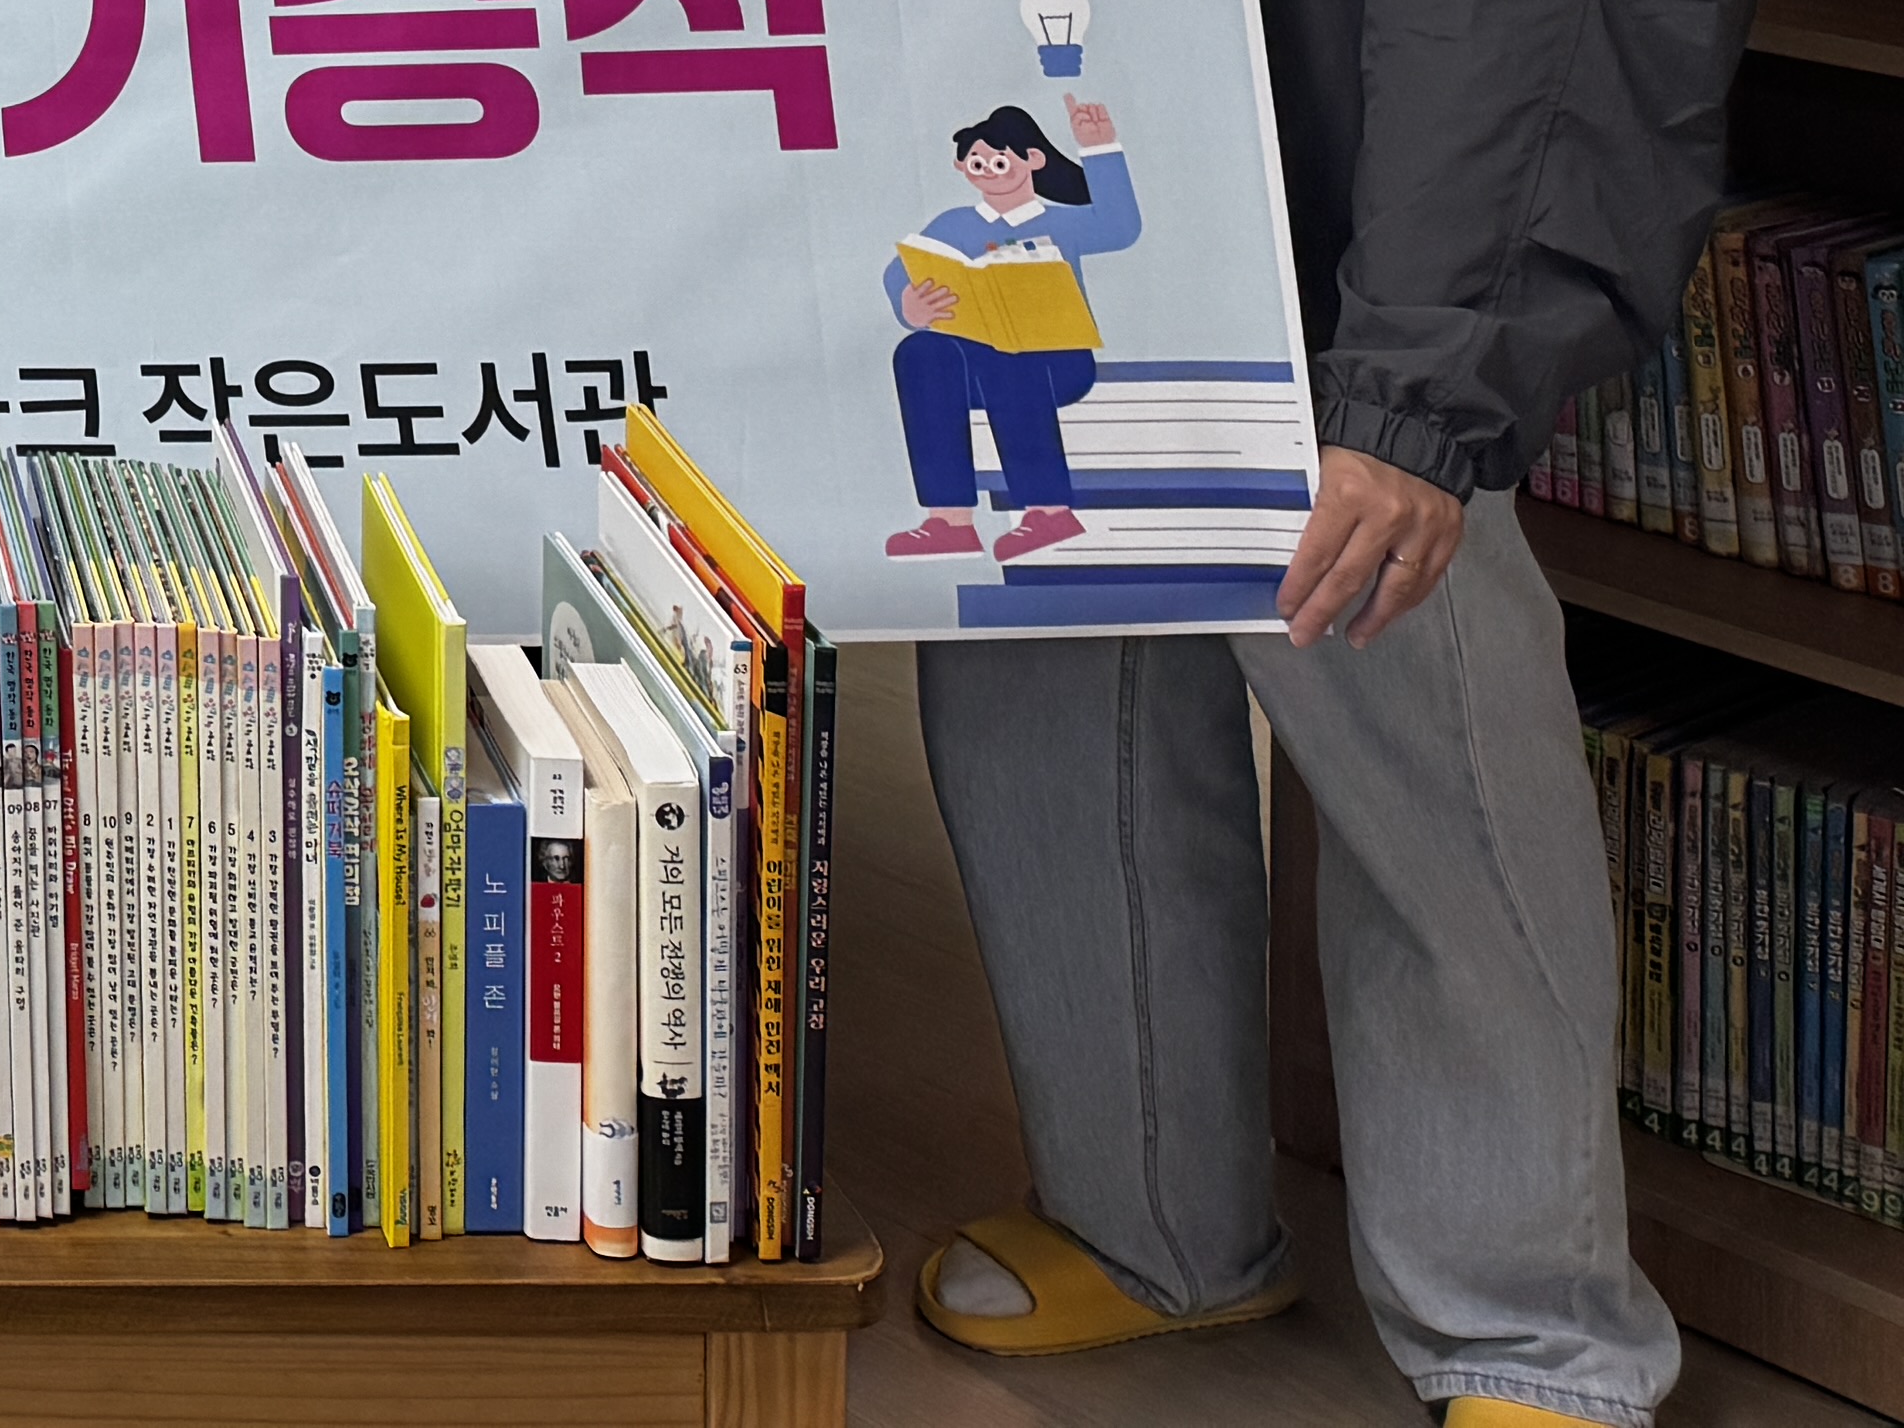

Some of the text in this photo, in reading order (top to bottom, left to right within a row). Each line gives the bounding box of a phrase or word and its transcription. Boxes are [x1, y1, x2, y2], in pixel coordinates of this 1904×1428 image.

[139, 348, 669, 470] 작은도서관
[733, 662, 749, 675] 63
[7, 804, 23, 815] 09
[24, 801, 41, 813] 08
[44, 800, 58, 810] 07
[82, 814, 92, 827] 8
[102, 816, 117, 829] 10
[124, 812, 133, 825] 9
[146, 814, 155, 827] 2
[167, 817, 174, 830] 1
[186, 815, 195, 829] 7
[207, 821, 217, 834] 6
[227, 822, 236, 836] 5
[246, 830, 255, 842] 4
[268, 830, 278, 843] 3
[392, 784, 410, 907] Where Is My House?
[11, 829, 23, 877] 송아지가
[65, 862, 78, 895] Draw
[550, 892, 565, 964] 파우스트 2
[482, 872, 508, 1010] 노 피플 존
[658, 844, 687, 1051] 거의 모든 전쟁의 역사
